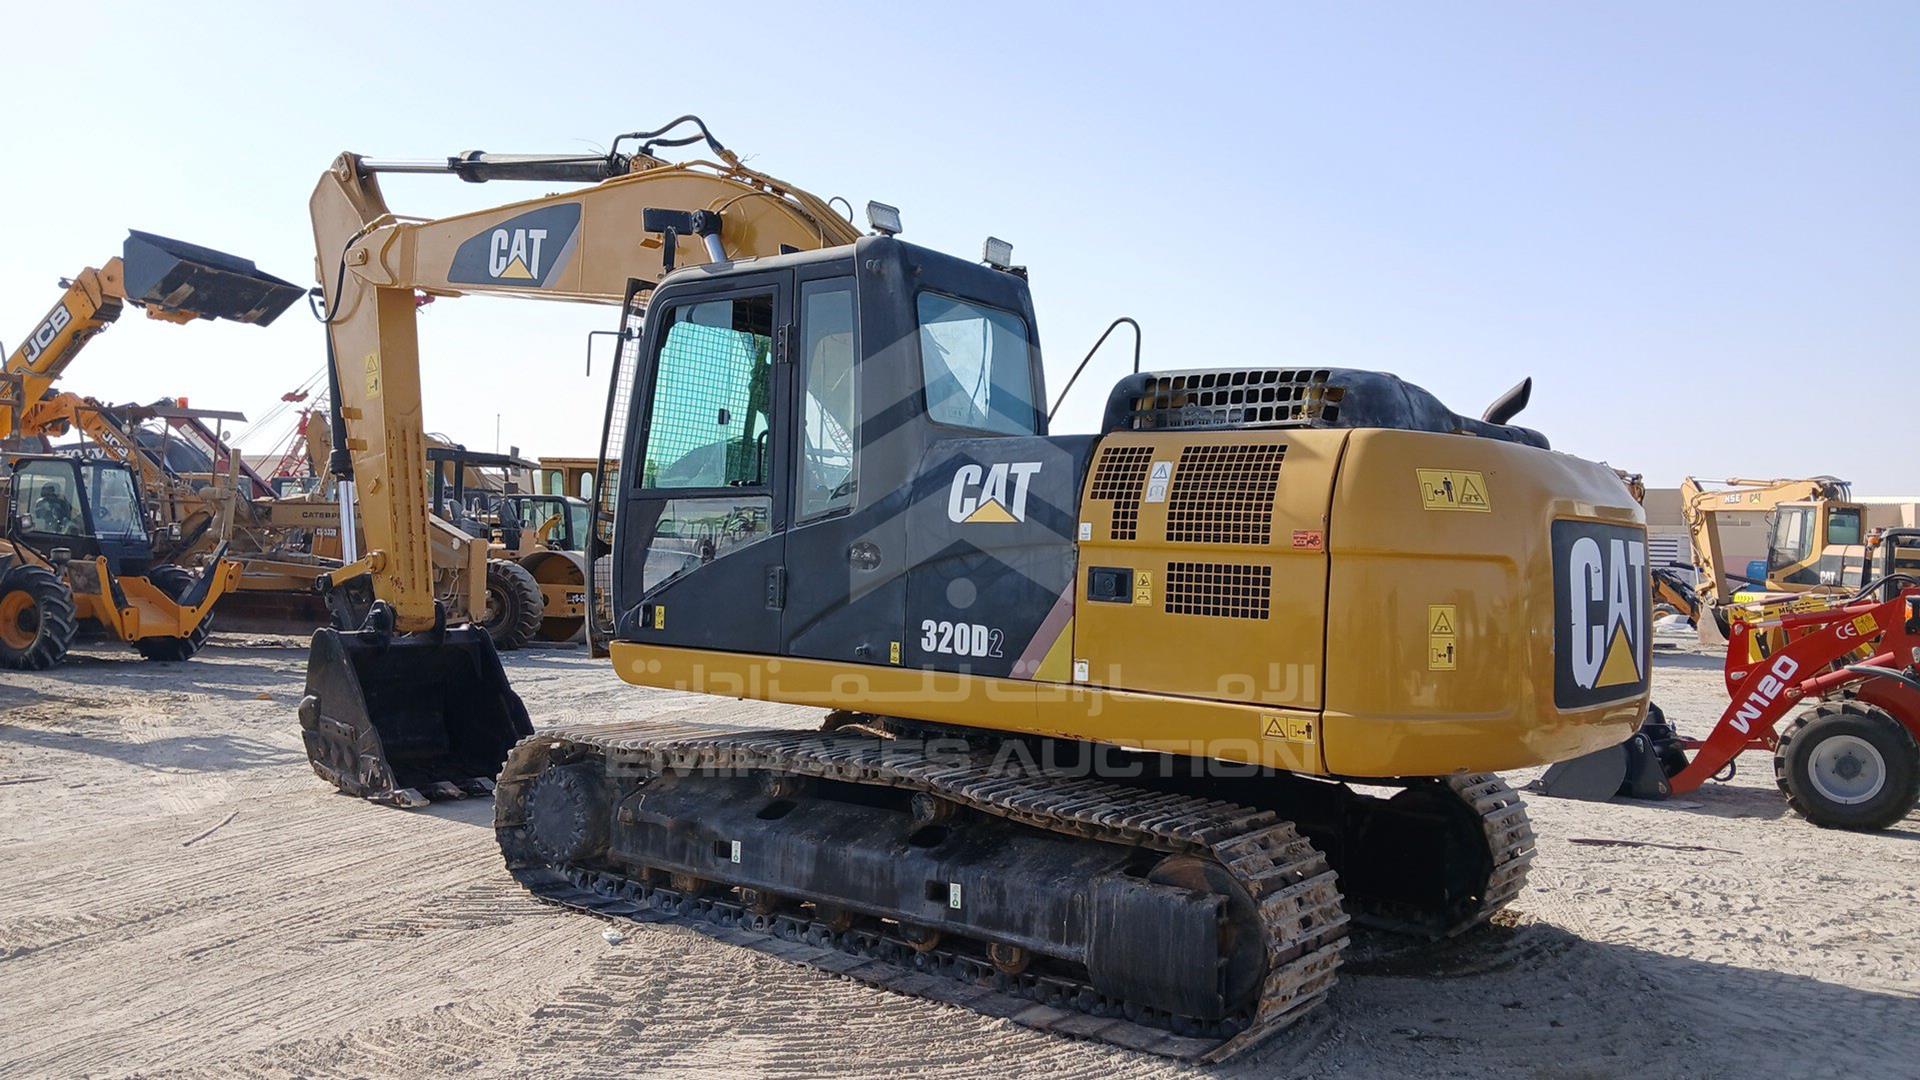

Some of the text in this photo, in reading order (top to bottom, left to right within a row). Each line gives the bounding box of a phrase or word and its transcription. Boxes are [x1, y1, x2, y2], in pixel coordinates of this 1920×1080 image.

[488, 228, 547, 279] CAT
[27, 305, 71, 363] JCB
[102, 431, 129, 457] JCB
[948, 462, 1042, 523] CAT
[1820, 570, 1836, 585] CAT
[921, 619, 1004, 658] 320D2
[1570, 537, 1645, 690] CAT
[1836, 622, 1857, 640] CE
[1729, 655, 1799, 735] W120
